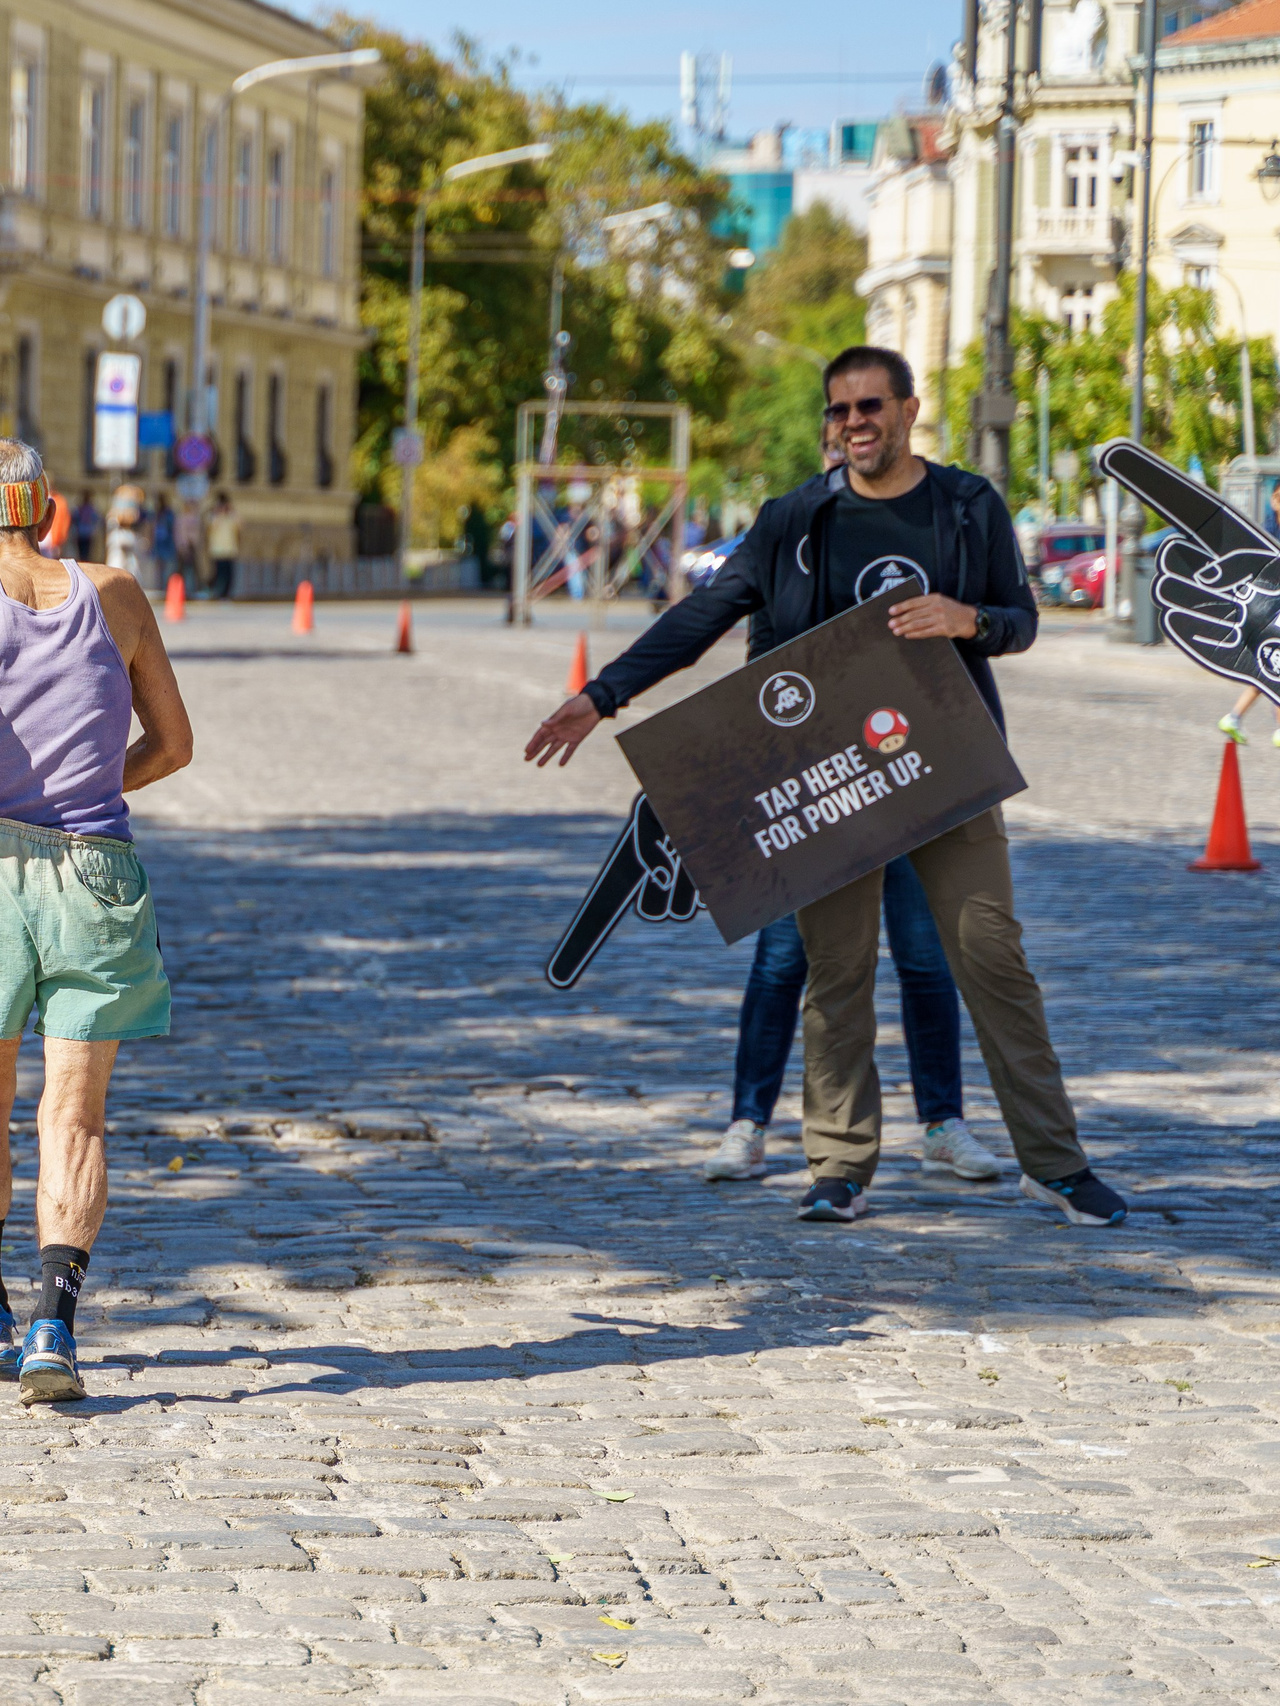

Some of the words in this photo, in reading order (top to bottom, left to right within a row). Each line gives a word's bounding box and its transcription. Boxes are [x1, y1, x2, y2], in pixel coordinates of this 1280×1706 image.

[754, 777, 802, 820] TAP
[801, 743, 869, 797] HERE
[754, 815, 807, 858] FOR
[802, 769, 893, 833] POWER
[887, 750, 933, 787] UP.
